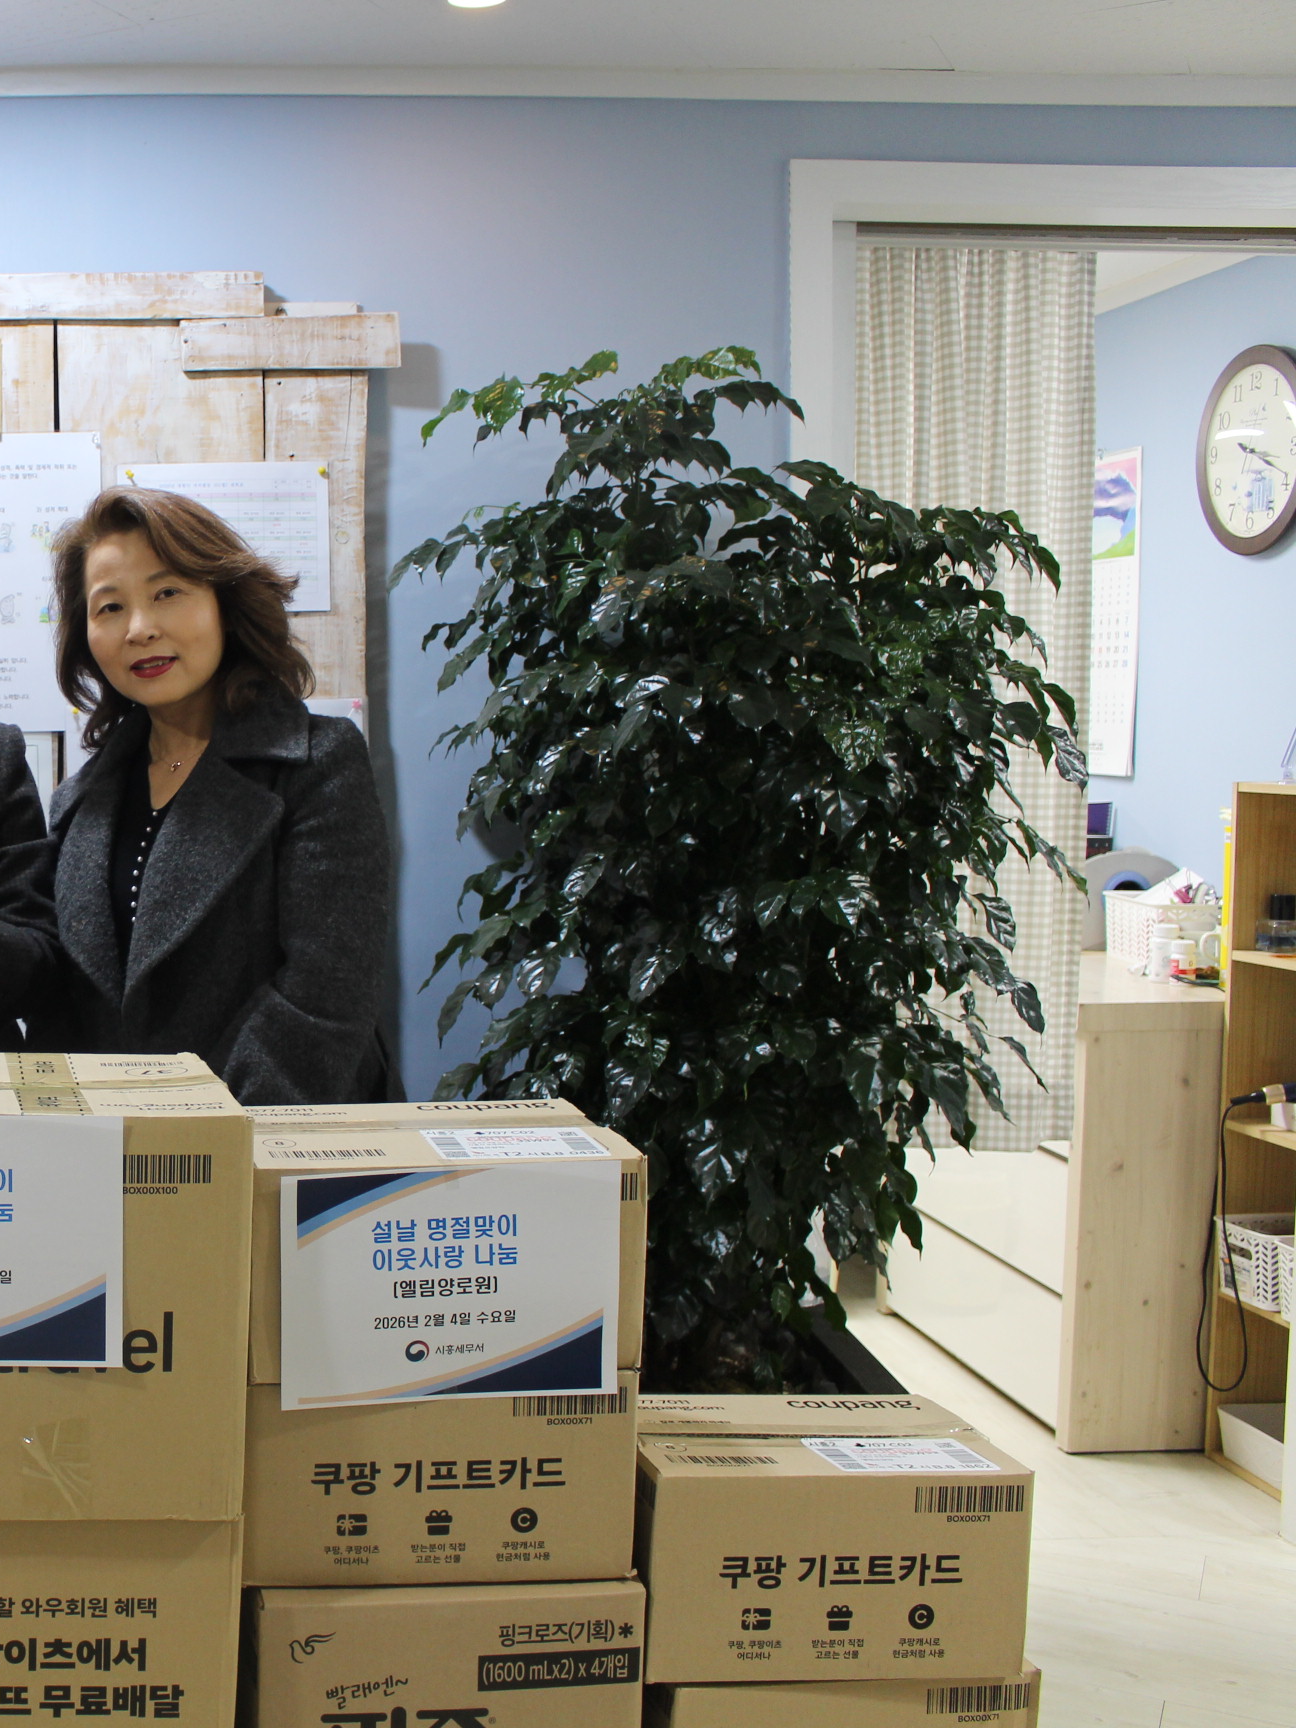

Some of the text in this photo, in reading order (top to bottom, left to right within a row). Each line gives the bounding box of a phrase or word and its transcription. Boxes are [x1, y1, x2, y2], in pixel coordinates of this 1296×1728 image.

[1249, 371, 1263, 391] 12
[1273, 377, 1279, 397] 1
[1233, 384, 1243, 403] 11
[1217, 411, 1231, 431] 10
[1210, 446, 1218, 465] 9
[1214, 478, 1222, 496] 8
[1281, 471, 1290, 491] 4
[1228, 503, 1236, 522] 7
[1266, 498, 1275, 519] 5
[1245, 511, 1254, 530] 6
[417, 1102, 555, 1112] coupang
[371, 1214, 518, 1243] 설날 명절맞이
[372, 1242, 519, 1272] 이웃사랑 나눔
[374, 1309, 517, 1330] 2026년 2월 4일 수요일
[435, 1342, 485, 1356] 시흥세무서
[787, 1399, 921, 1411] coupang
[546, 1416, 593, 1426] BOX00X71
[311, 1456, 567, 1496] 쿠팡 기프트카드
[946, 1514, 991, 1523] BOX00X71
[324, 1544, 380, 1555] 쿠팡, 쿠팡이츠
[410, 1541, 466, 1553] 받는분이 직접
[501, 1539, 546, 1550] 쿠팡캐시로
[334, 1556, 370, 1566] 어디서나
[415, 1553, 461, 1564] 고르는 선물
[495, 1550, 551, 1562] 현금처럼 사용
[719, 1553, 963, 1590] 쿠팡 기프트카드
[20, 1596, 109, 1619] 와우회원
[114, 1596, 159, 1619] 혜택
[727, 1639, 782, 1650] 쿠팡, 쿠팡이츠
[811, 1637, 864, 1649] 받는분이 직접
[898, 1636, 941, 1647] 쿠팡캐시로
[736, 1651, 771, 1661] 어디서나
[814, 1649, 859, 1660] 고르는 선물
[892, 1648, 945, 1659] 현금처럼 사용
[482, 1656, 526, 1685] (1600
[578, 1662, 586, 1678] x
[590, 1653, 629, 1680] 4개입
[39, 1683, 184, 1719] 무료배달
[957, 1713, 1000, 1723] BOX00X71
